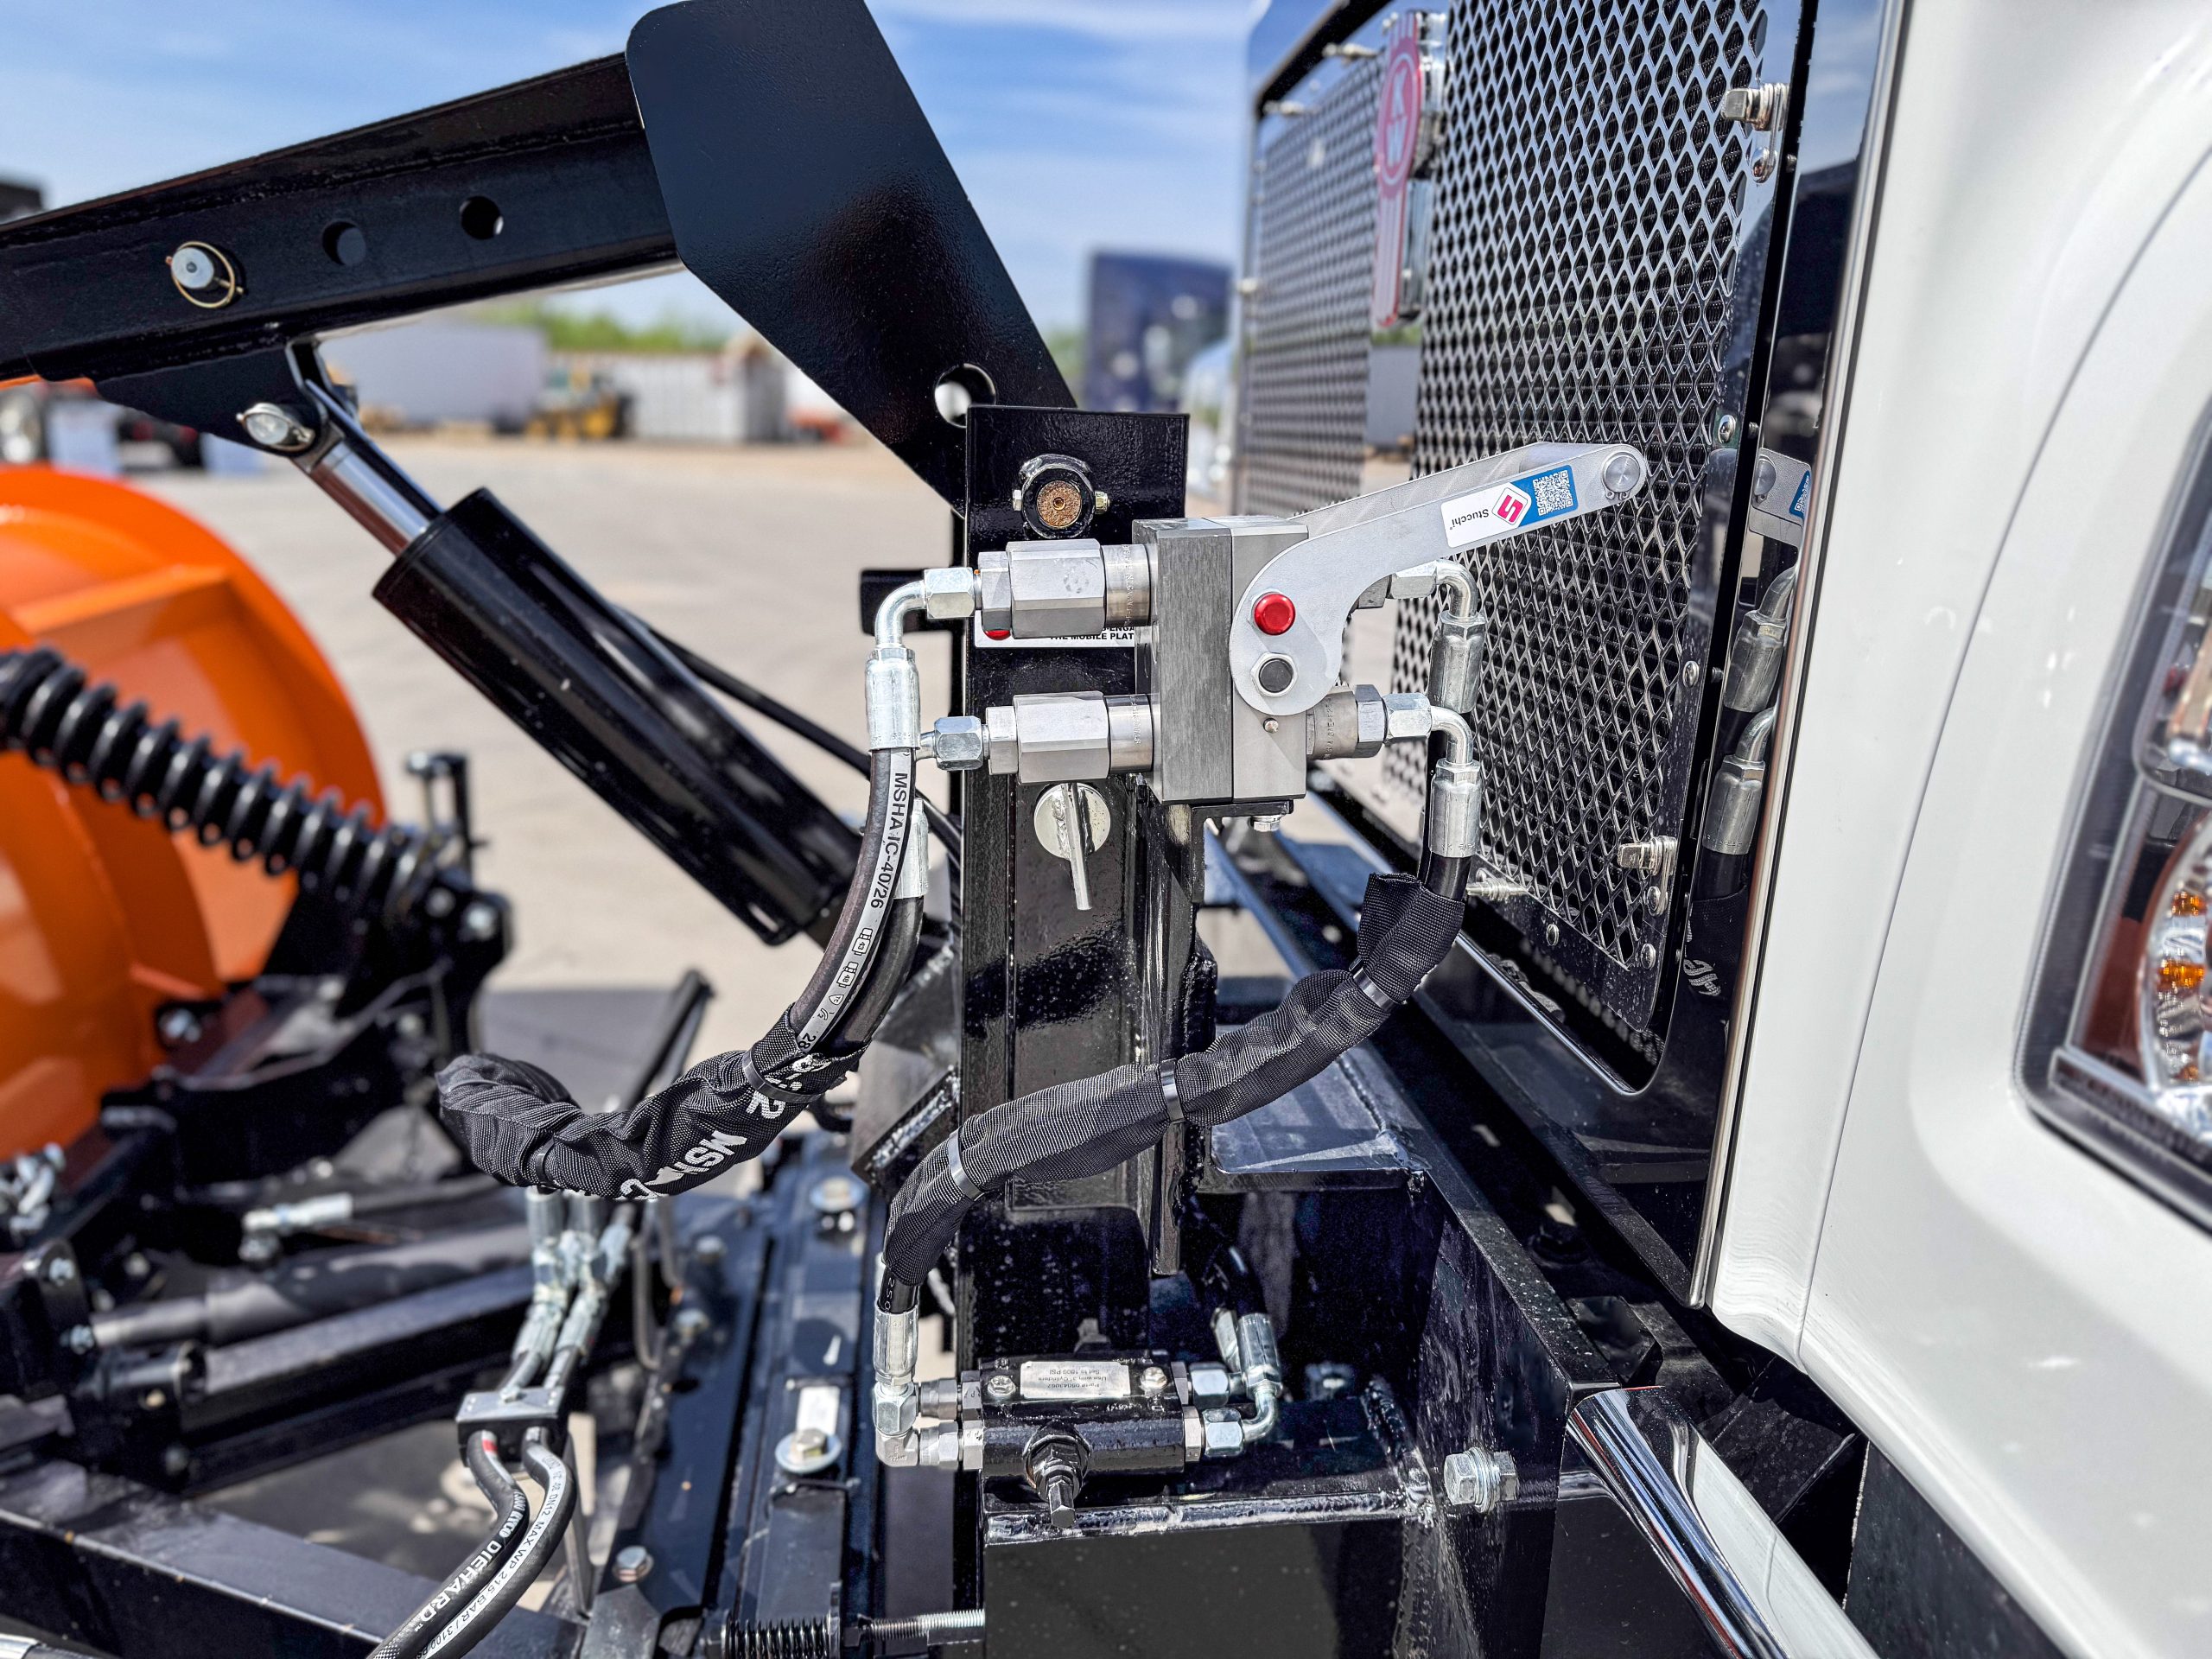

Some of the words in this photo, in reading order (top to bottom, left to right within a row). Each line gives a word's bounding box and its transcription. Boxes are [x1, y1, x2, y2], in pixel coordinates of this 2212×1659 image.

[1451, 508, 1490, 525] Stucchi
[889, 772, 908, 830] MSHA
[871, 836, 900, 908] IC-40/26
[857, 941, 866, 950] 43
[524, 1521, 544, 1546] MAX
[509, 1549, 526, 1569] WP
[487, 1571, 508, 1592] 215
[461, 1595, 486, 1622] BAR
[430, 1625, 454, 1649] 3100
